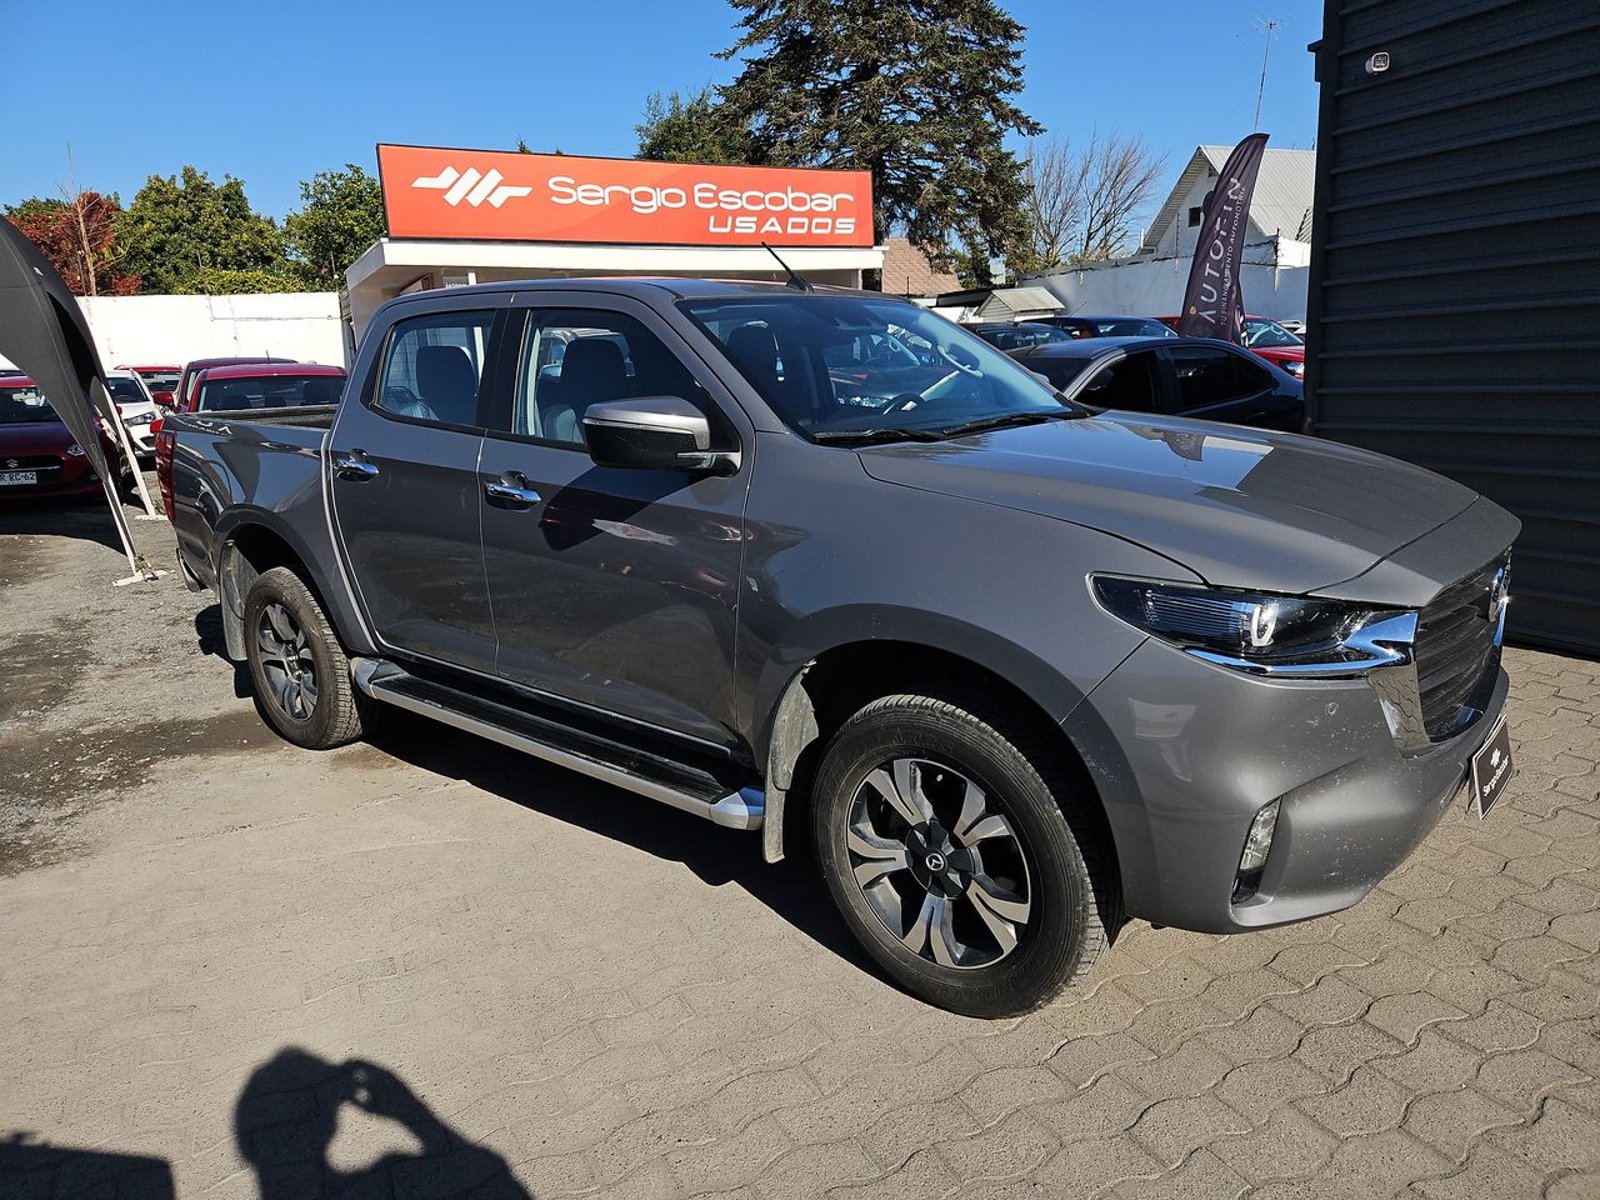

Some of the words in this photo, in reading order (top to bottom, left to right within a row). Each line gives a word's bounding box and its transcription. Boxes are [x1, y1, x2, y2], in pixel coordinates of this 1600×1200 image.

[548, 176, 687, 214] Sergio
[693, 182, 855, 213] Escobar
[708, 215, 856, 235] USADOS
